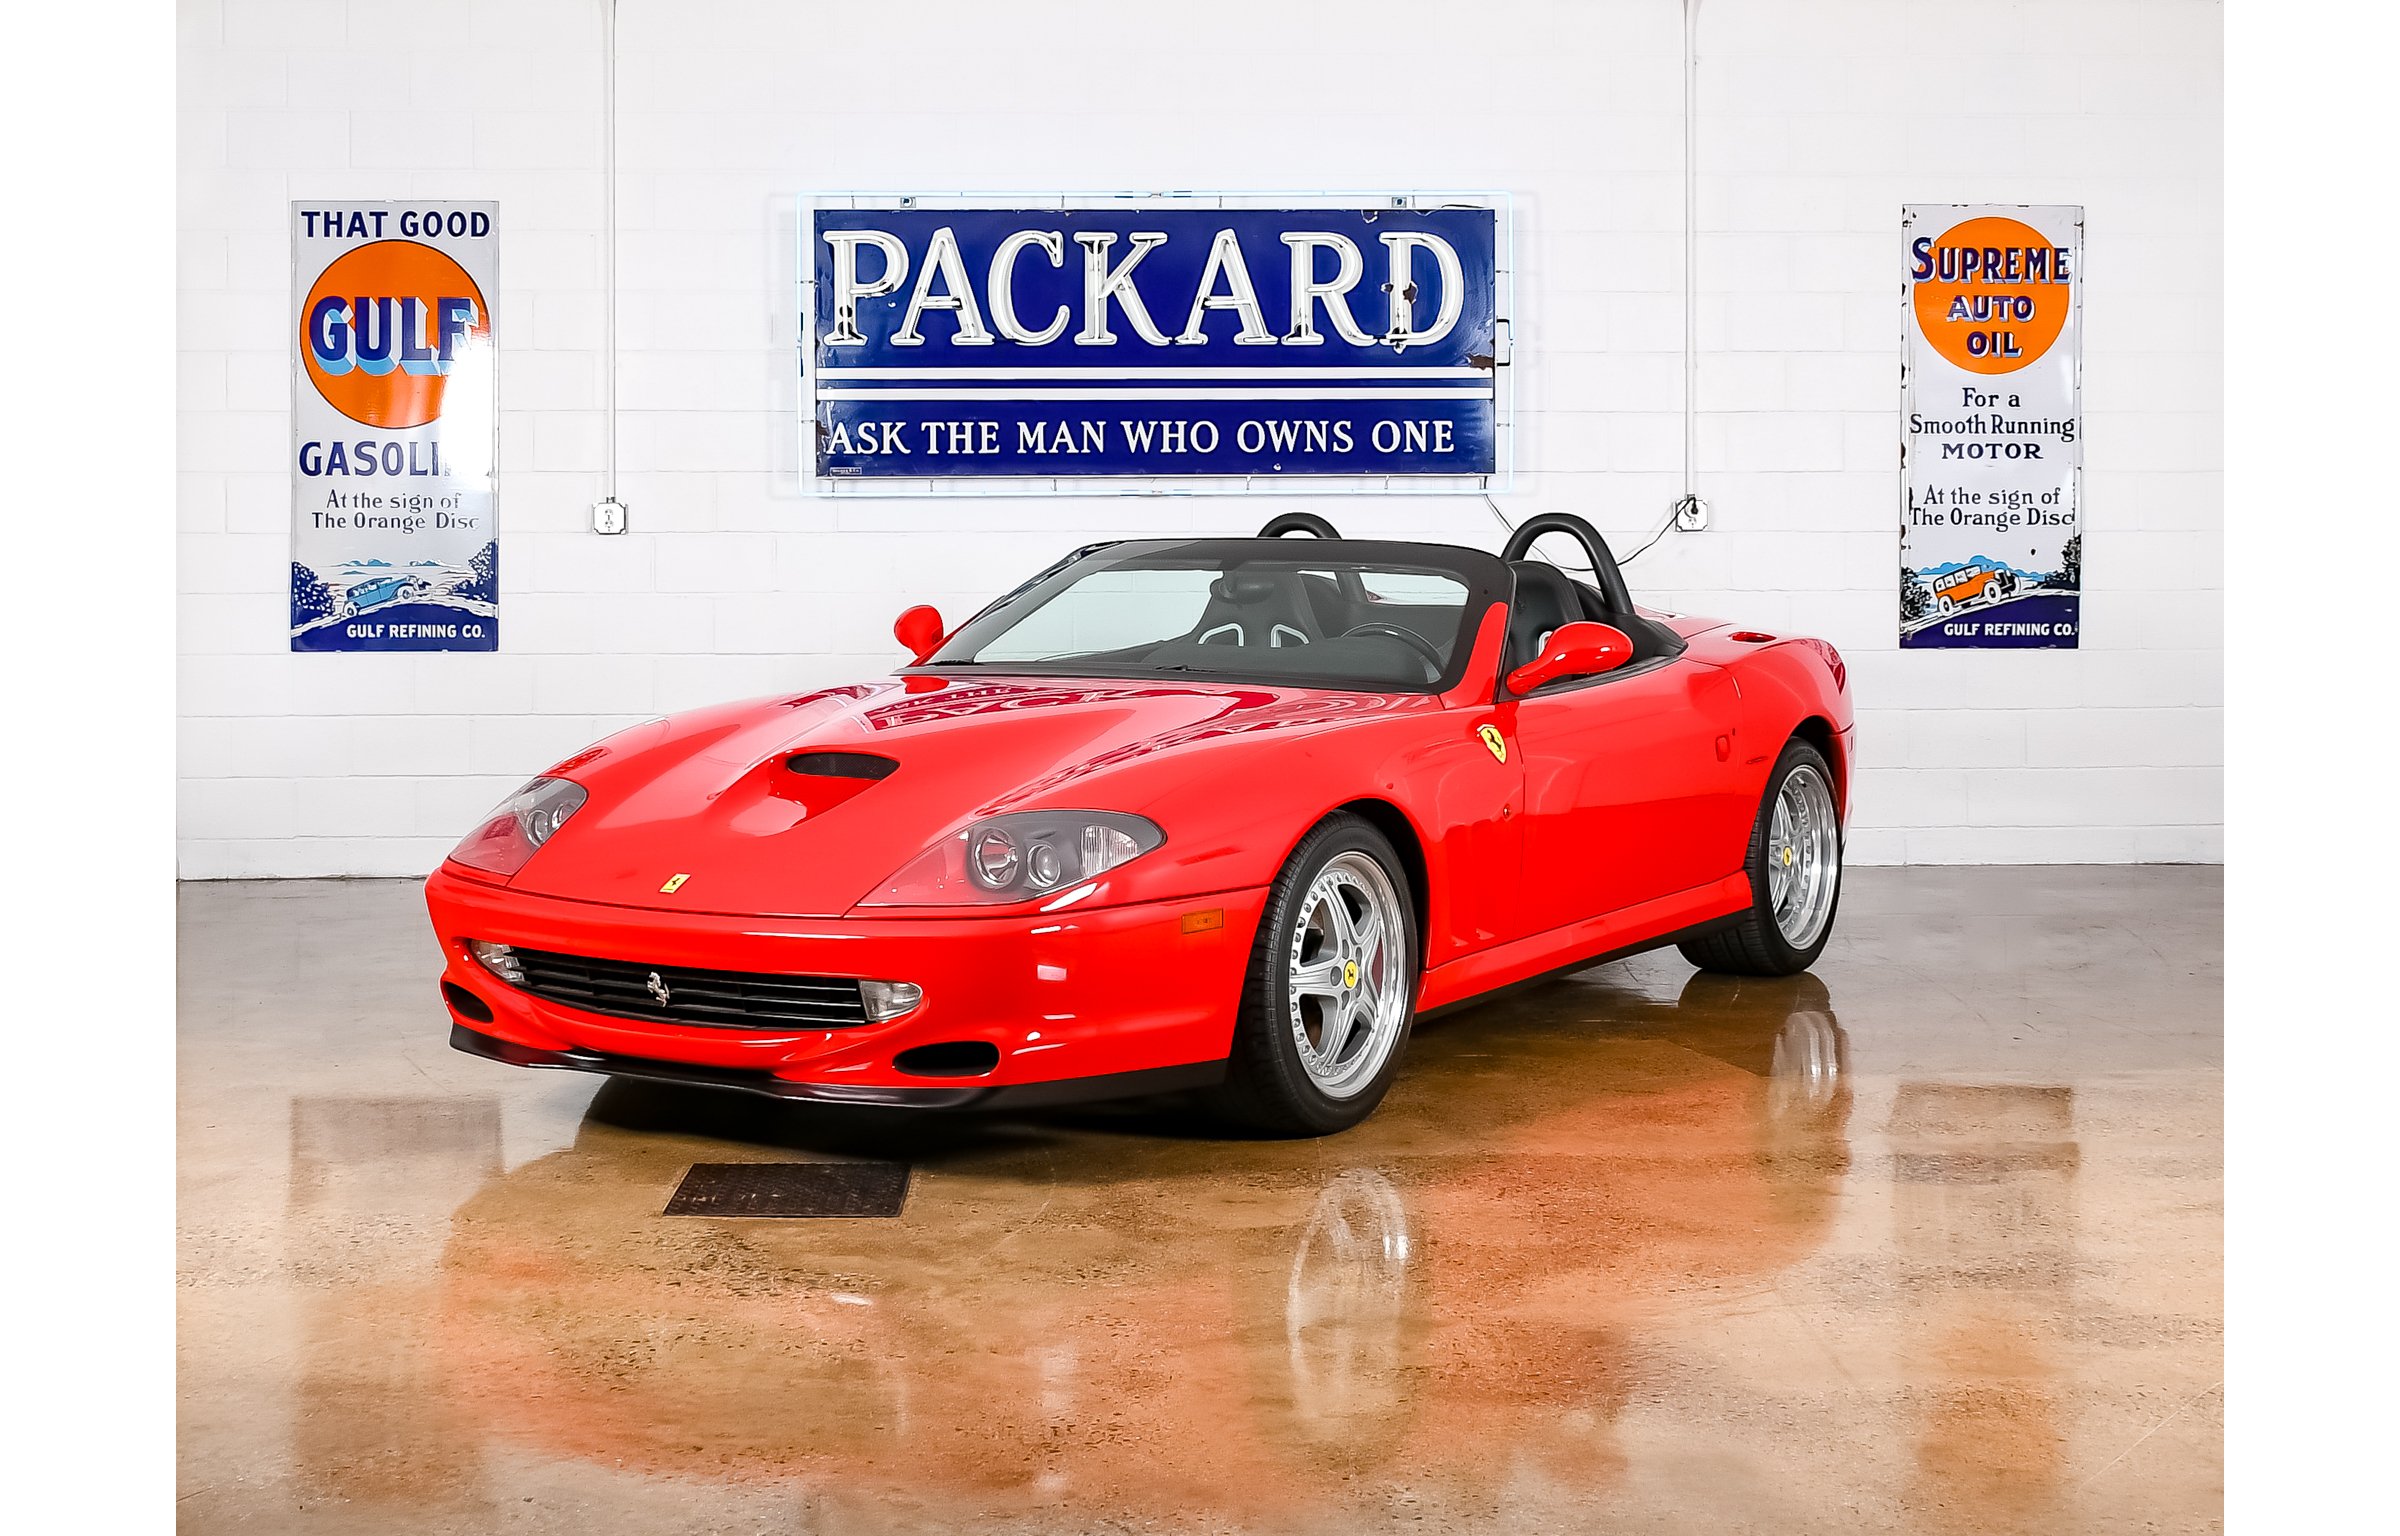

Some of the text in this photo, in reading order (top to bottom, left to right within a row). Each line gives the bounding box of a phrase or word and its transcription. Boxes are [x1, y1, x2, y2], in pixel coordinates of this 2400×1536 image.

[300, 211, 490, 237] THAT GOOD
[1911, 236, 2072, 284] SUPREME
[821, 226, 1465, 347] PACKARD
[1947, 294, 2036, 322] AUTO
[309, 295, 479, 376] GULF
[1966, 331, 2023, 358] OIL
[1962, 386, 2021, 408] For a
[826, 420, 1454, 454] ASK THE MAN WHO OWNS ONE
[1909, 413, 2075, 443] Smooth Running
[299, 441, 489, 477] GASOLI
[1941, 443, 2044, 460] MOTOR
[326, 488, 462, 514] At the sign of
[1923, 485, 2061, 510] At the sign of
[312, 511, 480, 534] The Orange Disc
[1912, 507, 2075, 533] The Orange Disc
[346, 624, 486, 639] GULF REFINING CO.
[1944, 623, 2076, 636] GULF REFINING CO.
